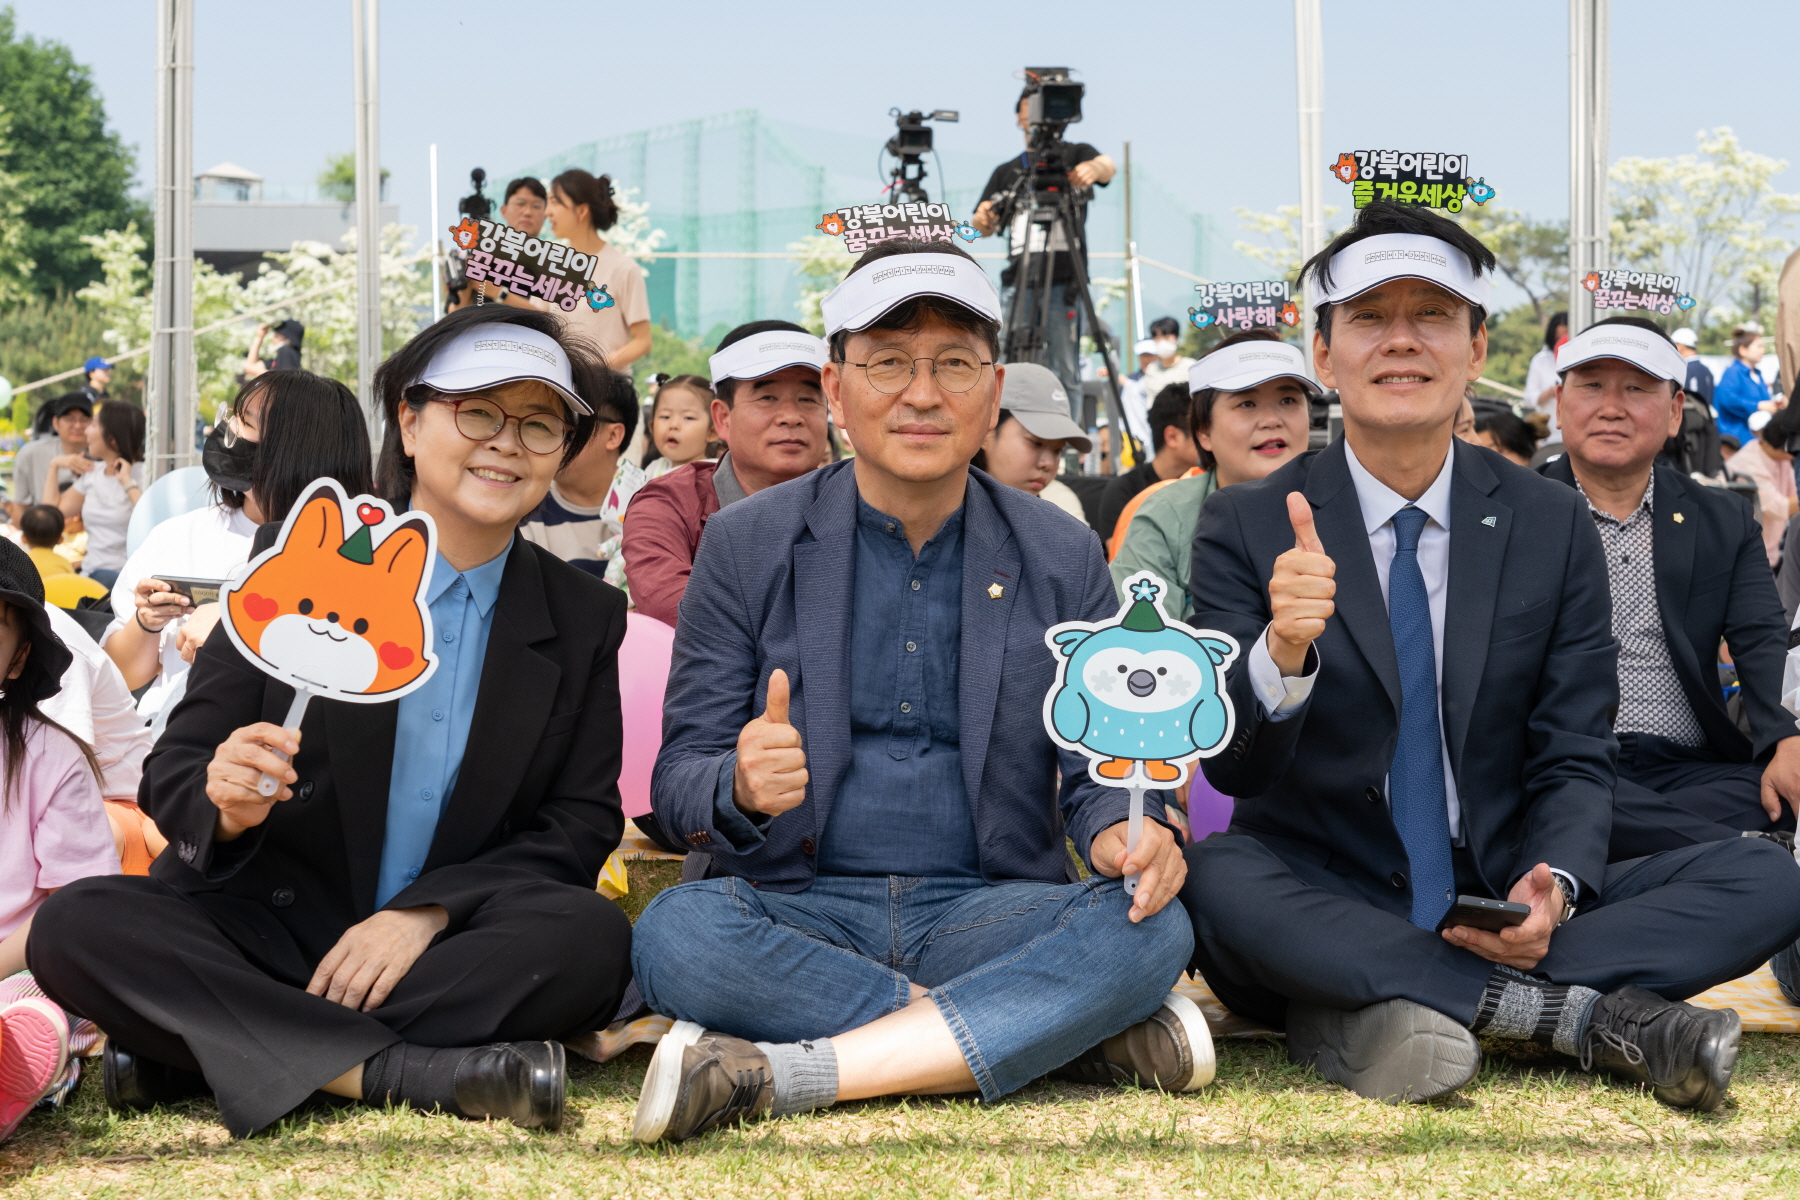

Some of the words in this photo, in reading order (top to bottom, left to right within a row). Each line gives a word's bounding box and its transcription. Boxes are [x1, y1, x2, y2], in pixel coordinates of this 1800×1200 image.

[1354, 151, 1467, 180] 강북어린이
[838, 203, 951, 230] 강북어린이
[479, 220, 598, 281] 강북어린이
[465, 249, 586, 312] 꿈꾸는세상
[1195, 280, 1290, 308] 강북어린이
[1598, 269, 1680, 293] 강북어린이
[1594, 289, 1676, 315] 꿈꾸는세상
[1214, 306, 1276, 331] 사랑해
